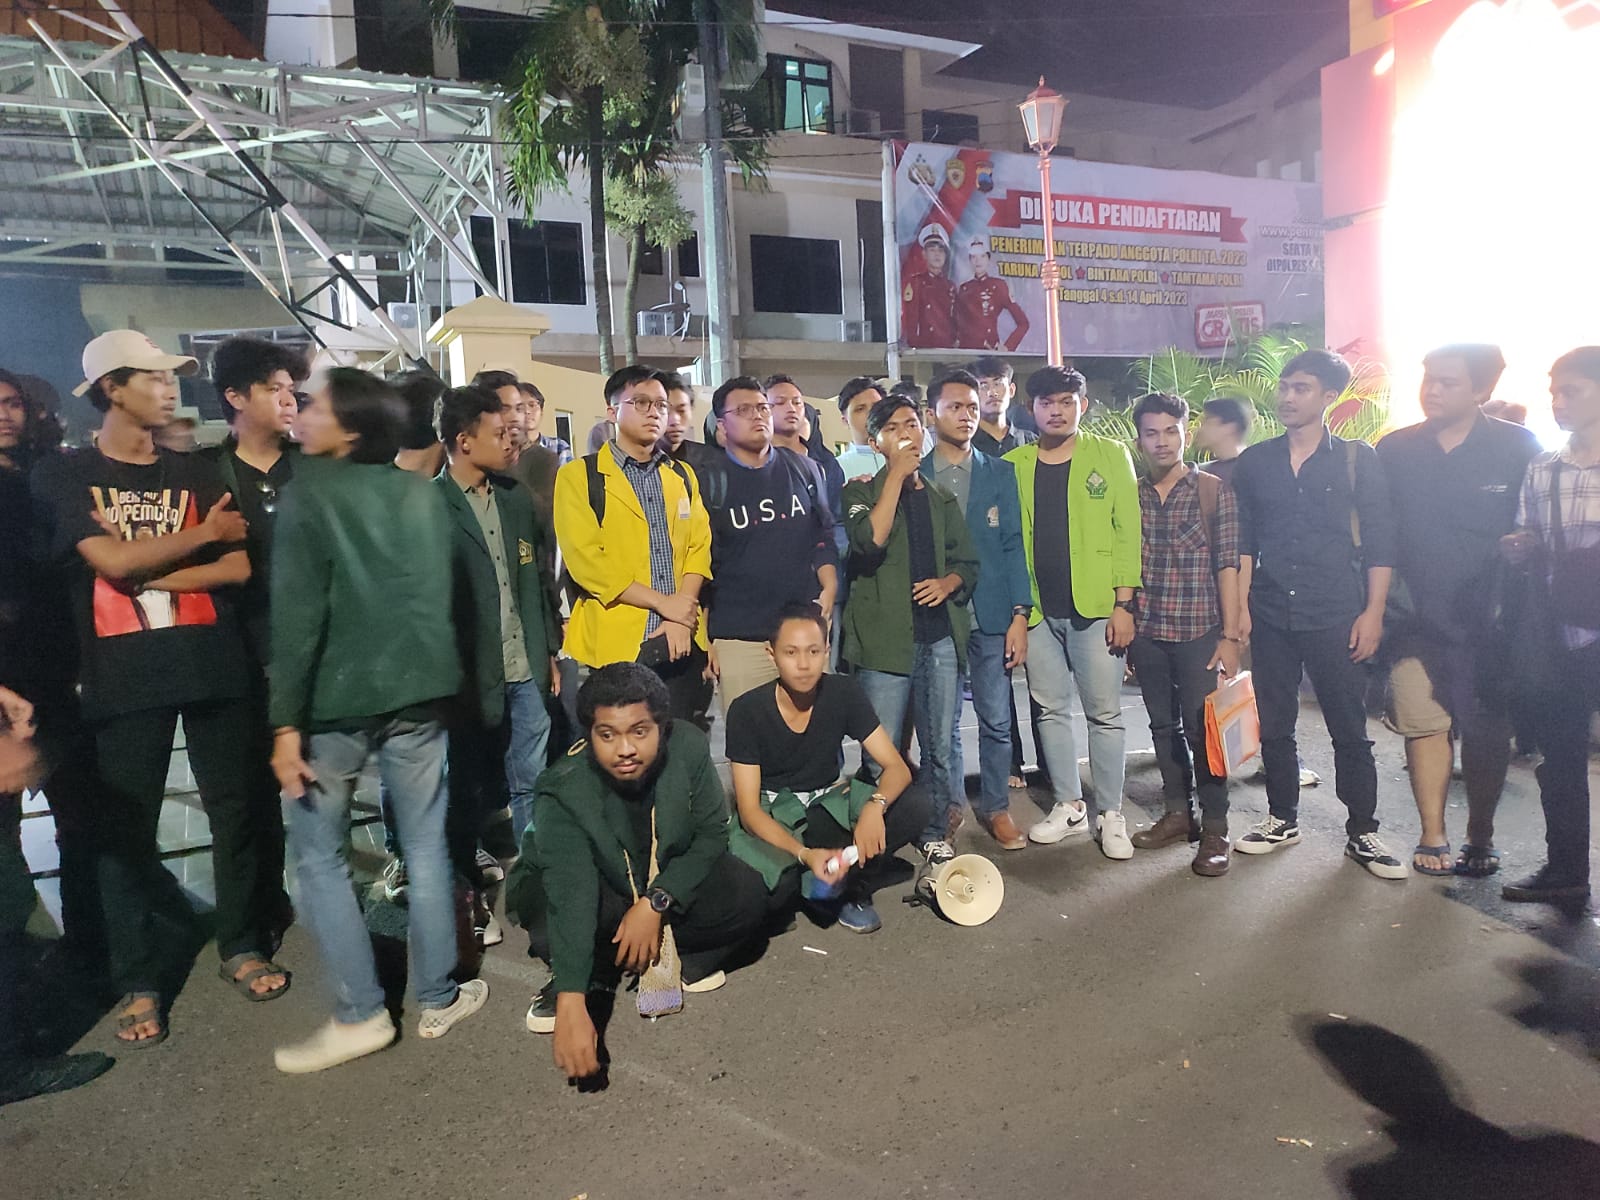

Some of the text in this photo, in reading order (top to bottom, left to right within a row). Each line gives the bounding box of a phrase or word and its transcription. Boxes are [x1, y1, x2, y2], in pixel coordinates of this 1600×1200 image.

[1019, 196, 1221, 233] DIUKA PENDAFTARAN
[1068, 241, 1118, 260] TERPADU
[1120, 245, 1170, 263] ANGGOTA
[1172, 248, 1202, 265] POLRI
[1221, 251, 1247, 266] 2023
[998, 262, 1040, 278] TARUNA
[1087, 267, 1130, 283] BINTARA
[1131, 269, 1158, 284] POLRI
[1171, 271, 1217, 287] TAMTAMA
[1059, 286, 1099, 304] Tanggal
[1100, 289, 1108, 303] 4
[1127, 289, 1138, 304] 14
[1163, 291, 1188, 306] 2023
